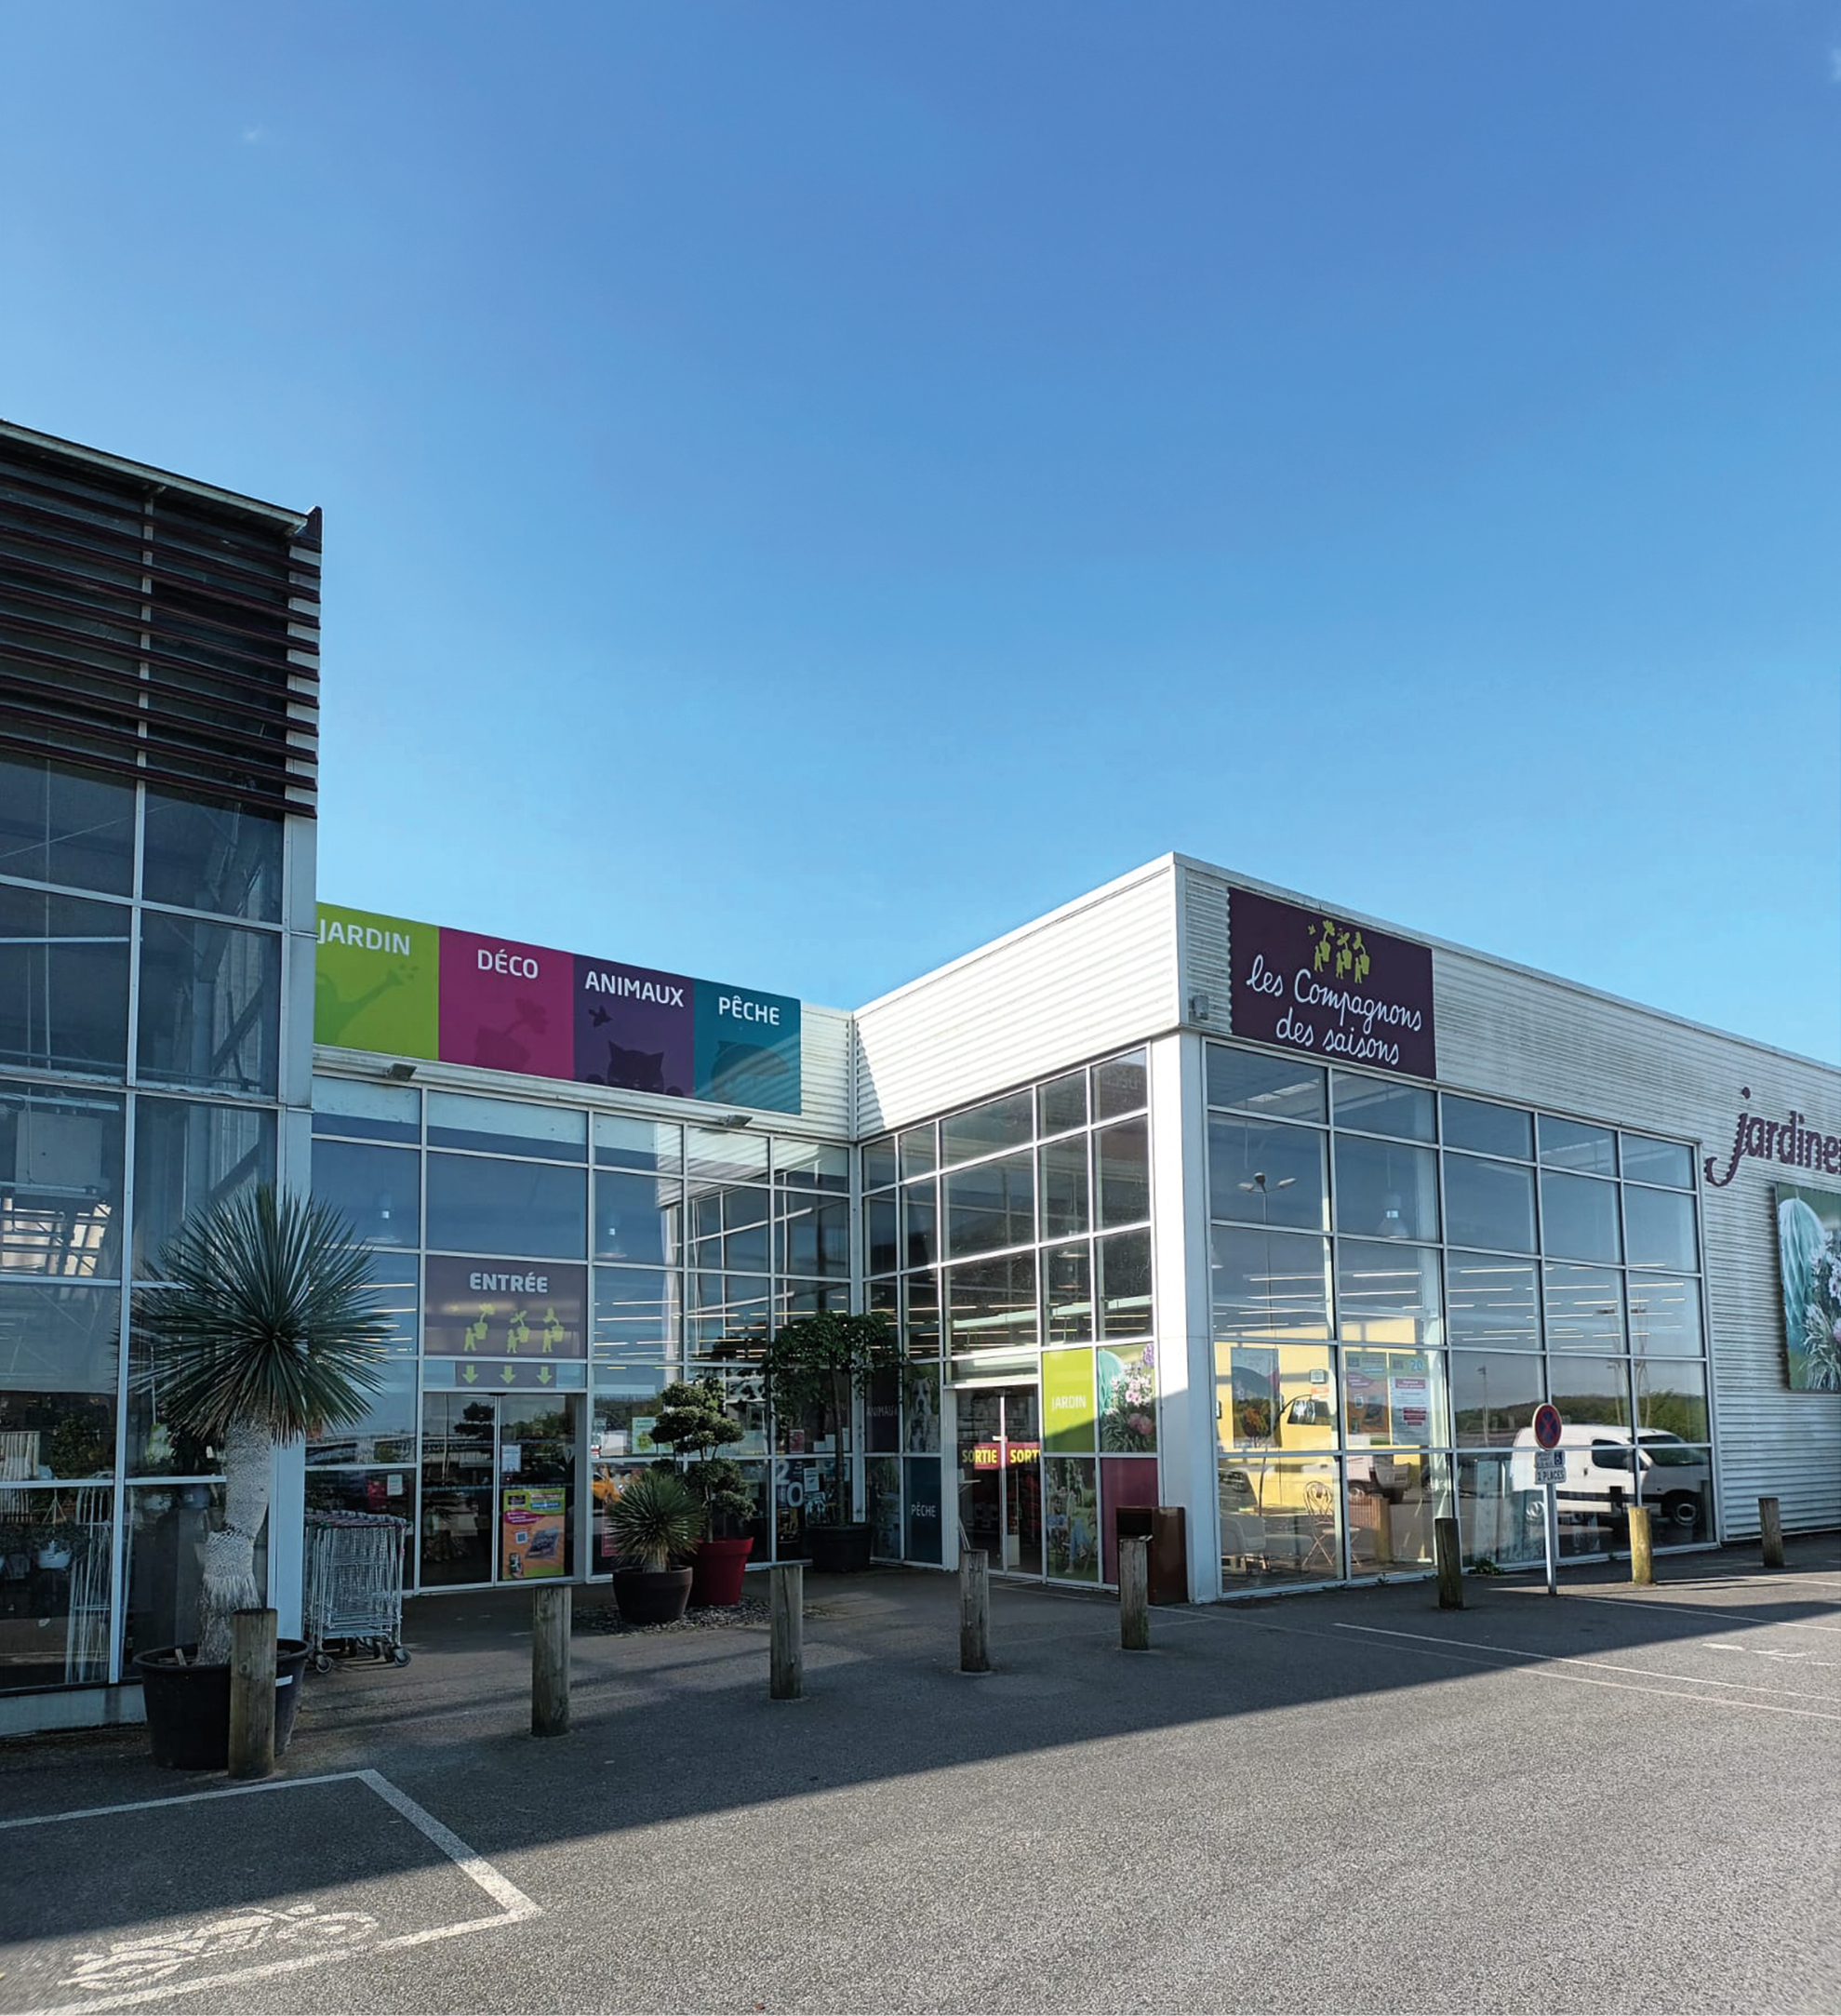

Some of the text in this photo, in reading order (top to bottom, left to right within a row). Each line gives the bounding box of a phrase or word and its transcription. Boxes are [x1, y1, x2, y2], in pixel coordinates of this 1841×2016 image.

[317, 918, 410, 956] JARDIN
[477, 948, 540, 980] DÉCO
[584, 969, 685, 1008] ANIMAUX
[1246, 955, 1422, 1035] les Compagnons
[718, 995, 780, 1026] PÊCHE
[1275, 1007, 1399, 1065] des saisons
[469, 1272, 548, 1293] ENTRÉE
[1051, 1395, 1087, 1411] JARDIN
[961, 1449, 997, 1463] SORTIE
[1542, 1469, 1565, 1481] PLACES
[911, 1501, 937, 1518] PÊCHE
